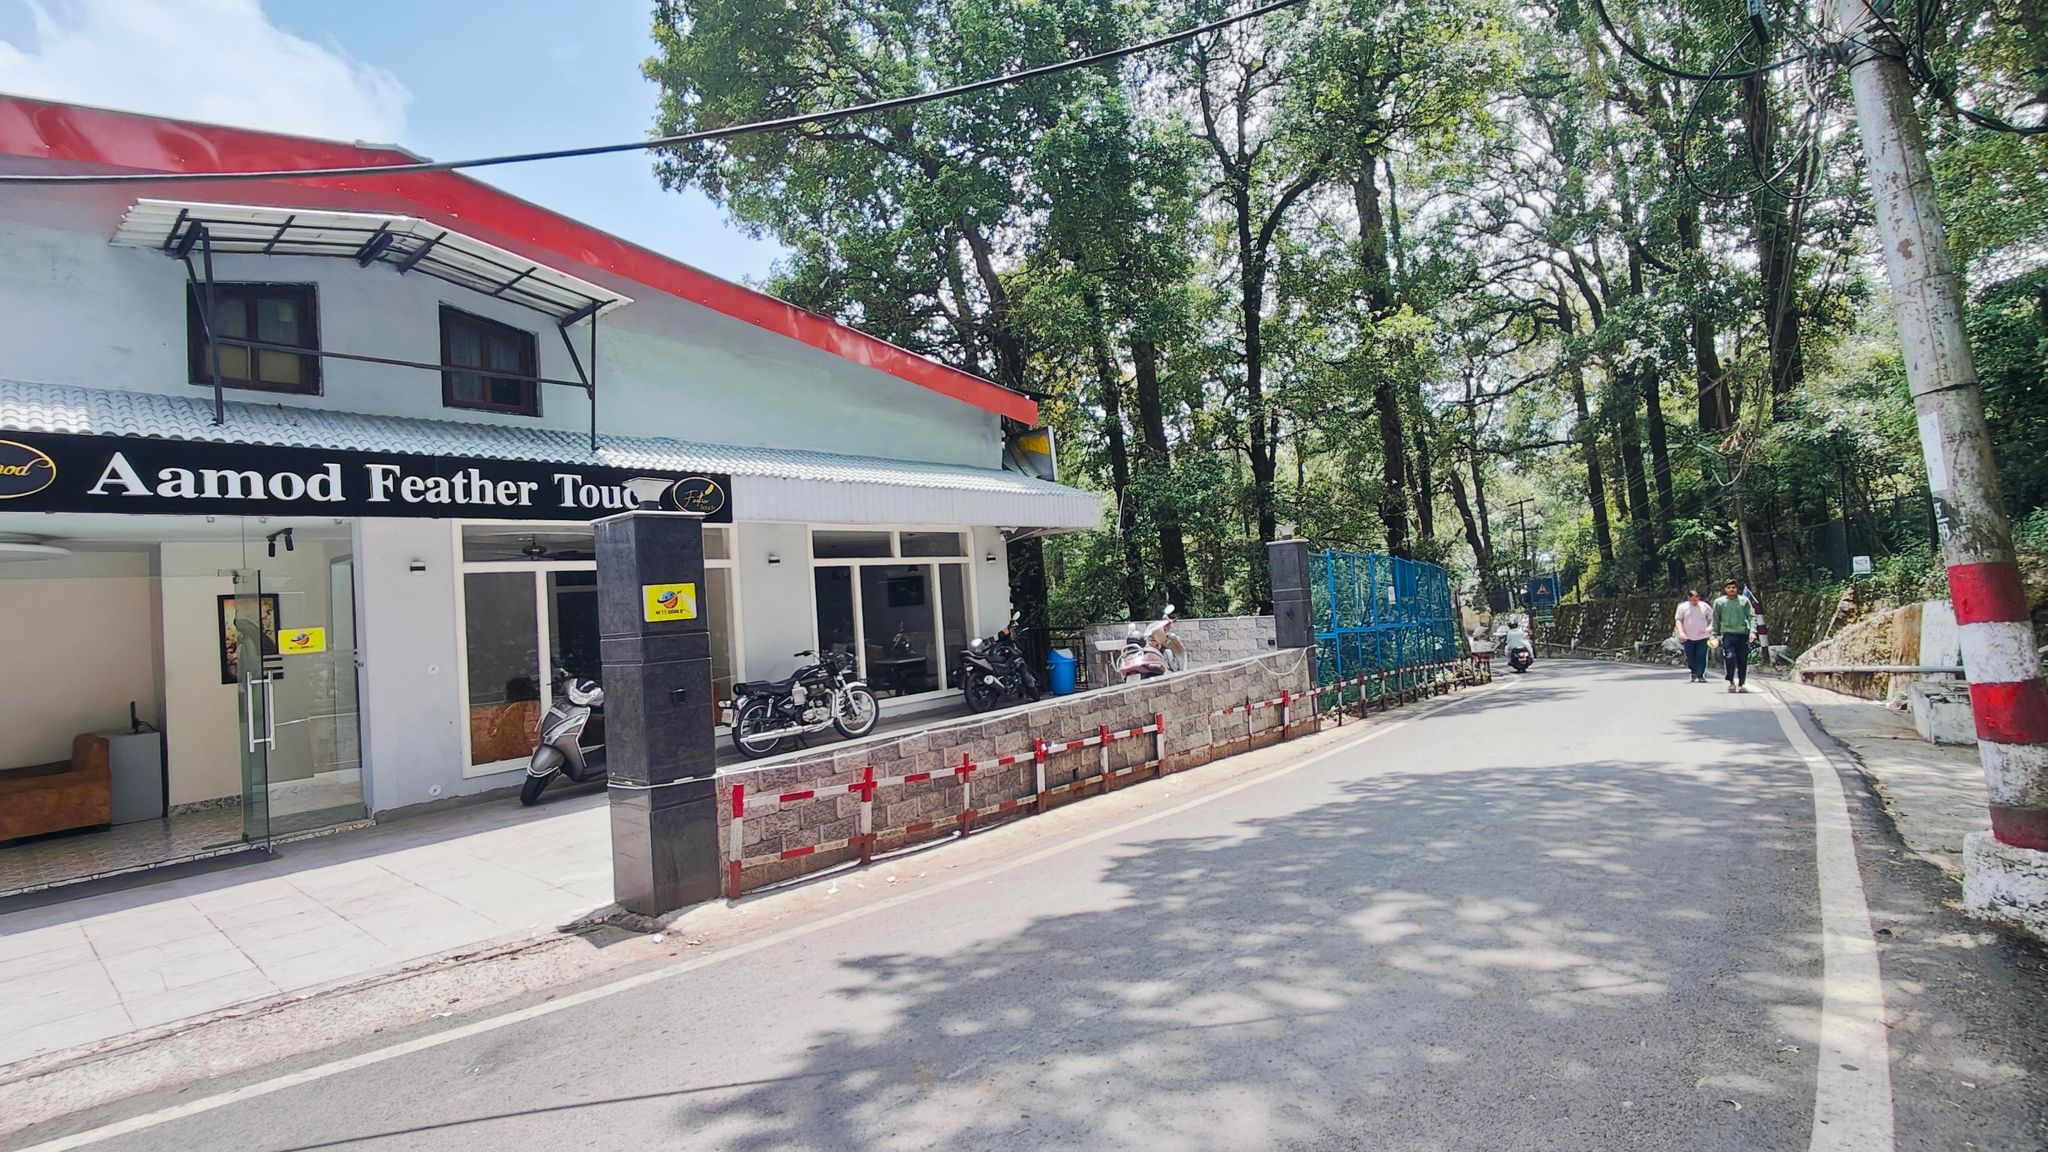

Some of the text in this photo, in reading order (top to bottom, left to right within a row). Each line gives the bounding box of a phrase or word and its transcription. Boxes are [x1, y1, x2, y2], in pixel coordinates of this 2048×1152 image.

[87, 451, 663, 509] Aamod Feather Touc
